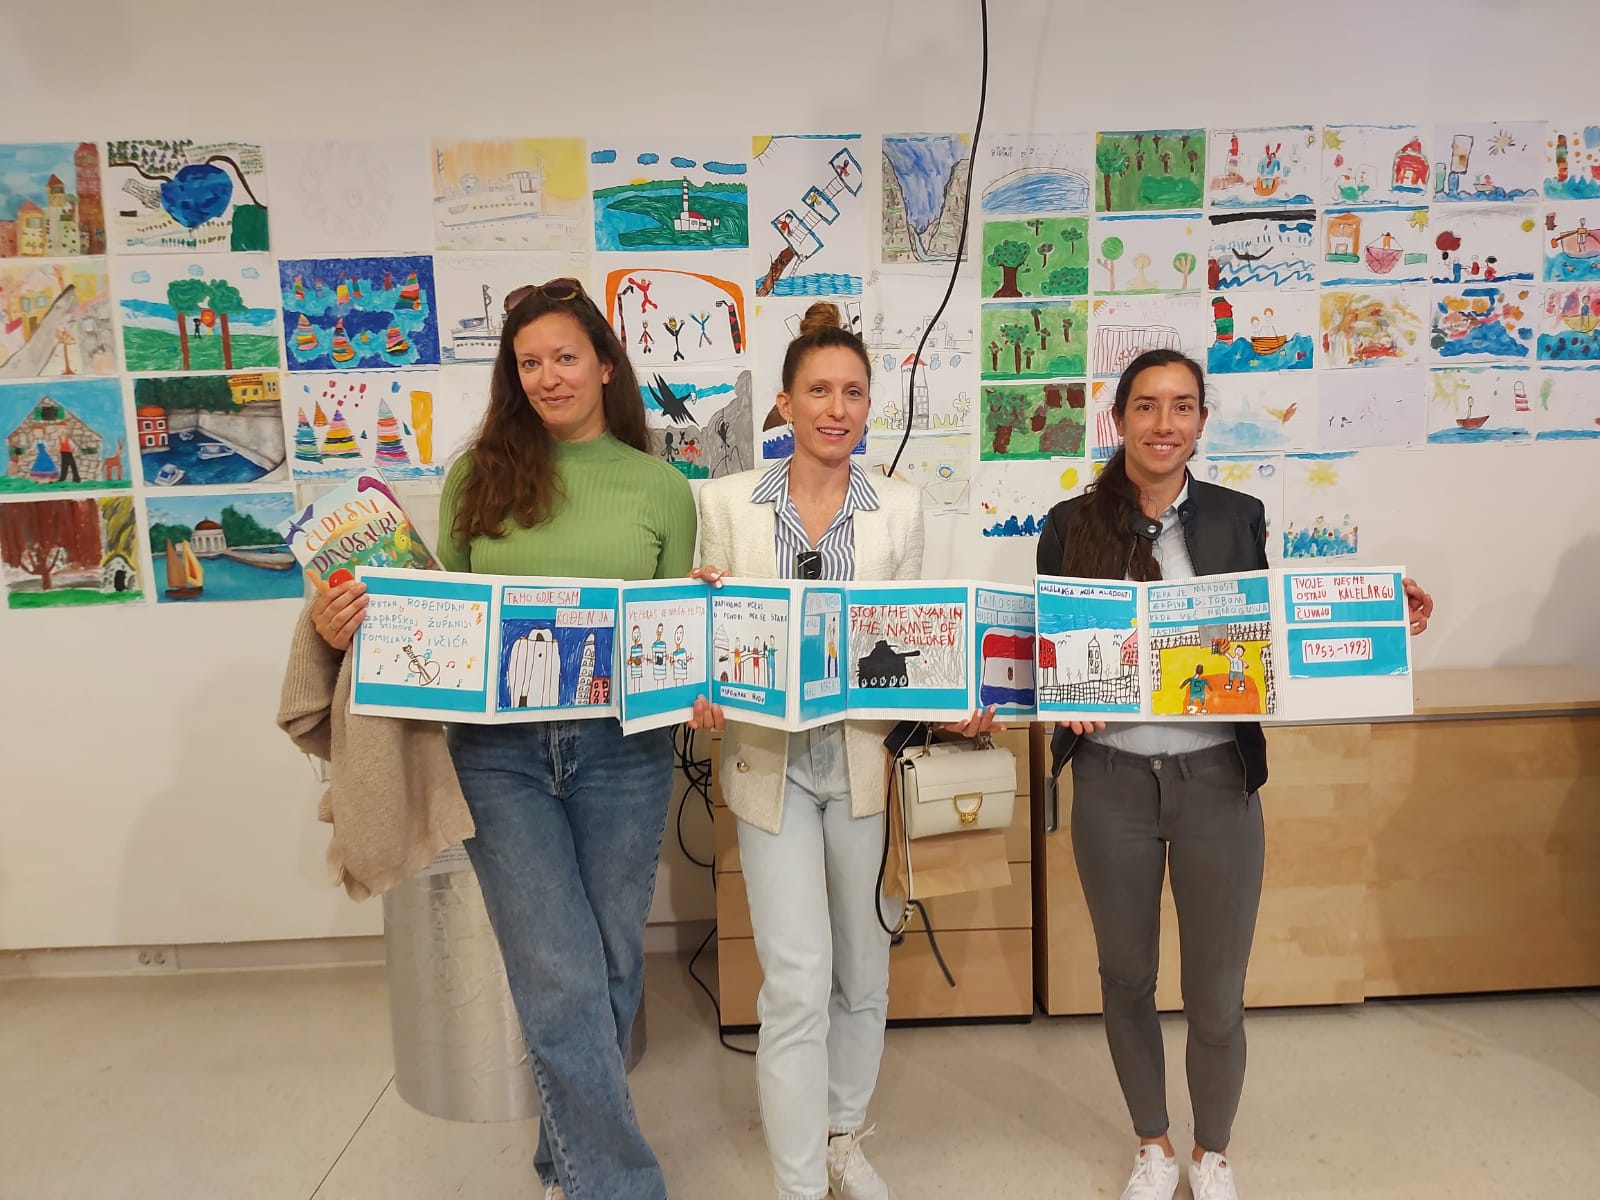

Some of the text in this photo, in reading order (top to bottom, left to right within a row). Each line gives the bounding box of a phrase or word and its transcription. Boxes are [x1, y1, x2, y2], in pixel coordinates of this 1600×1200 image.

[305, 499, 380, 551] ČUDESNI
[312, 512, 398, 574] DINOSAURI
[1193, 582, 1233, 593] MLADOST
[1293, 576, 1364, 589] TVOJE PJESME
[507, 591, 579, 606] TAMO GDJE SAM
[1296, 584, 1393, 600] OSTAJU KALELARGU
[850, 606, 962, 620] STOP THE WAR IN
[850, 620, 956, 636] THE NAME OF
[362, 633, 414, 644] TOMISLAVA
[904, 634, 955, 646] CHILDREN
